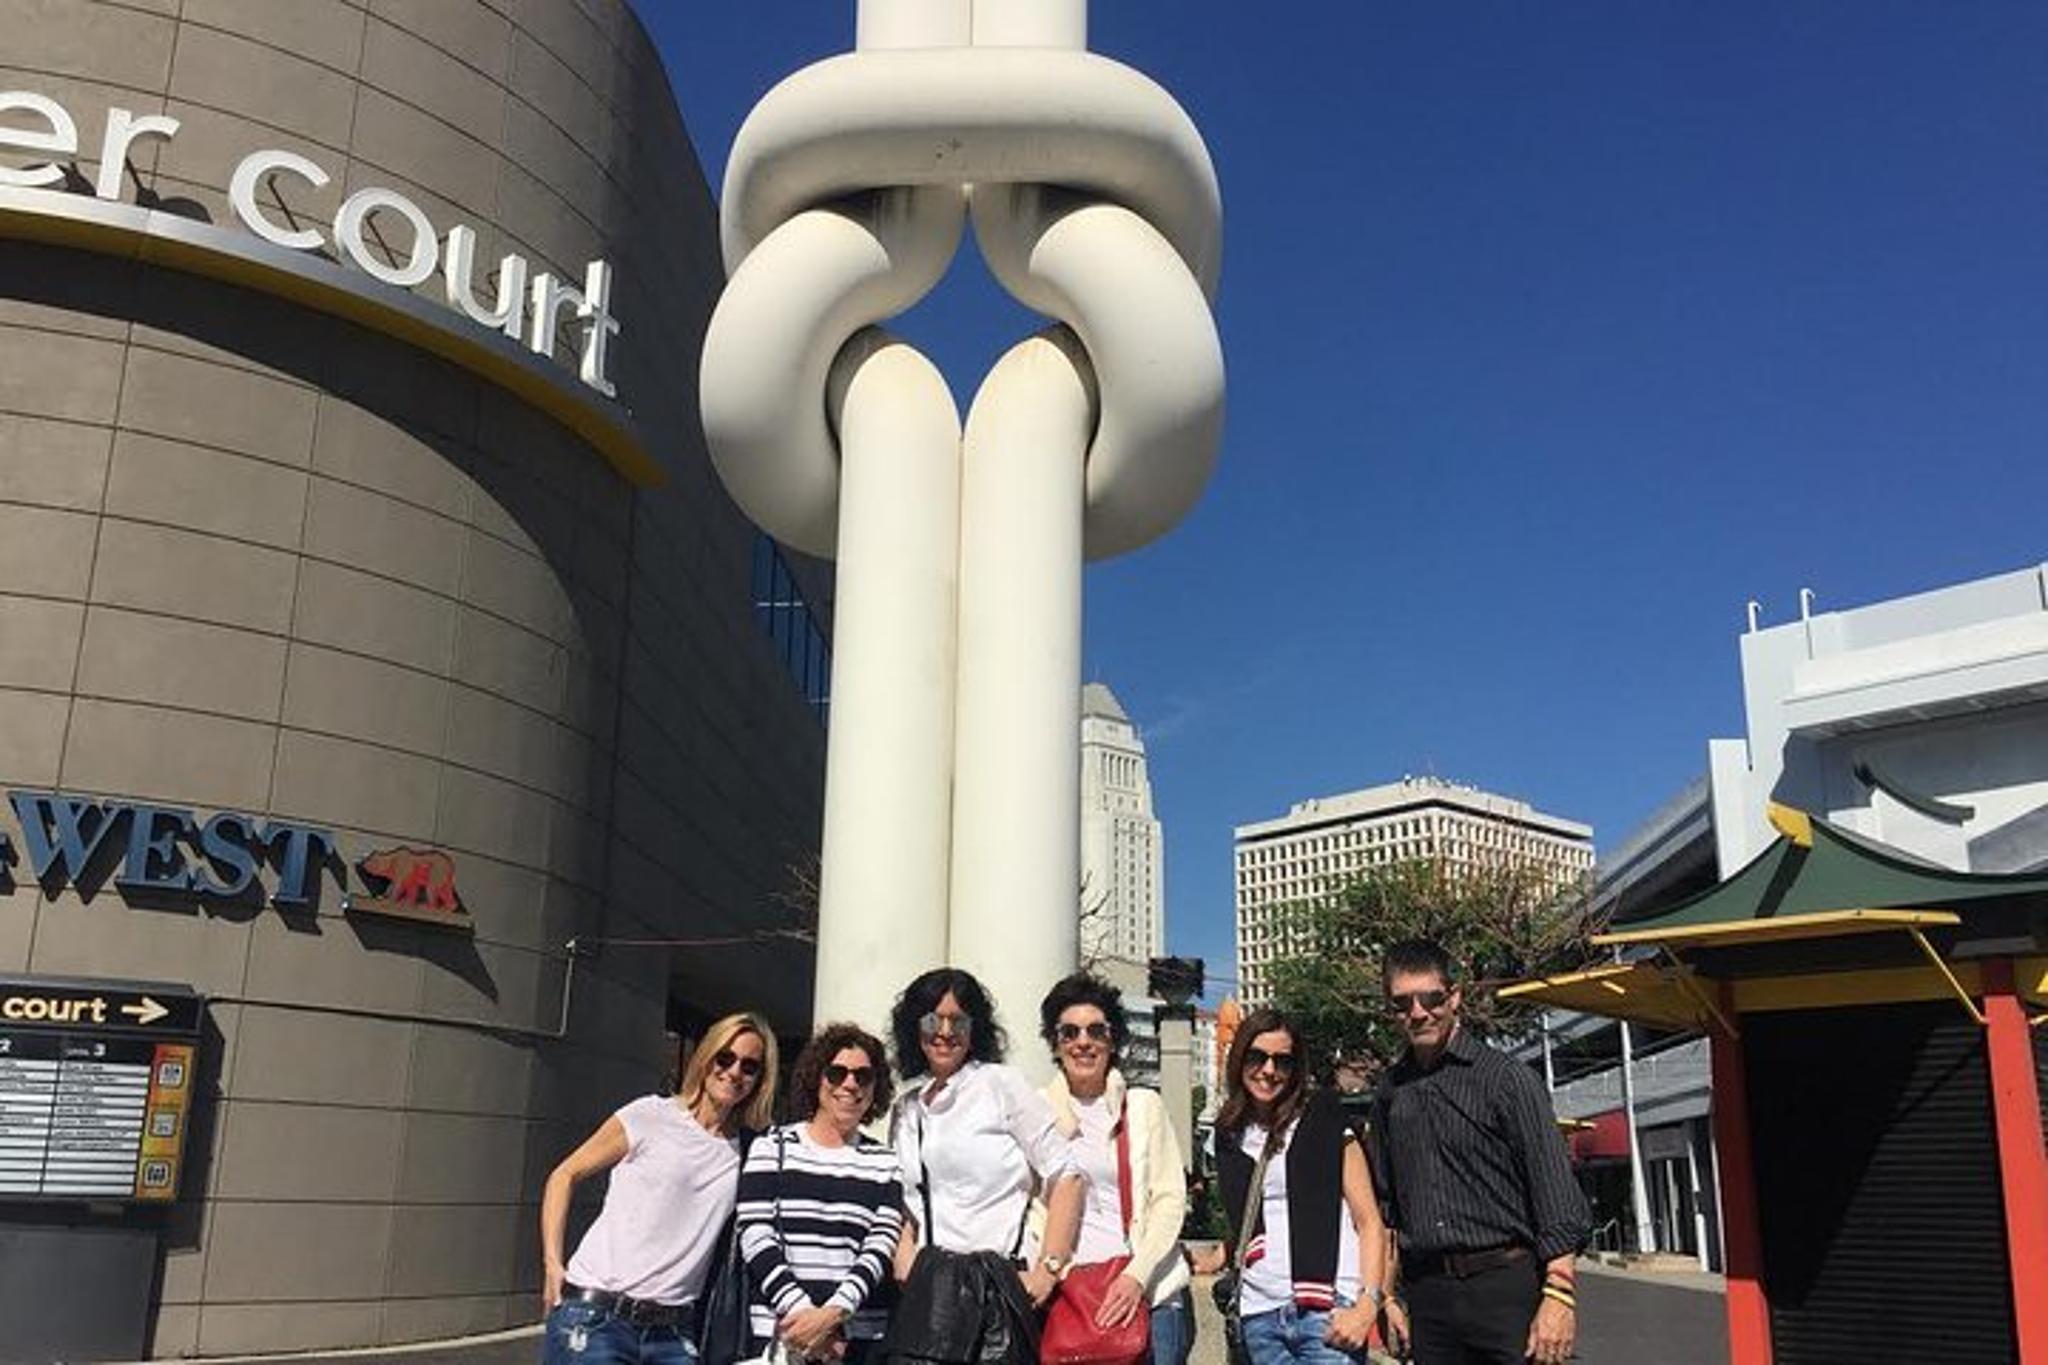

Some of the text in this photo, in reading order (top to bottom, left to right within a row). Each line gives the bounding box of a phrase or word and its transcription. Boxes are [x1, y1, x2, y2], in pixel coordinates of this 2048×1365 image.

[229, 149, 620, 399] court
[8, 790, 335, 903] WEST
[3, 997, 106, 1022] court
